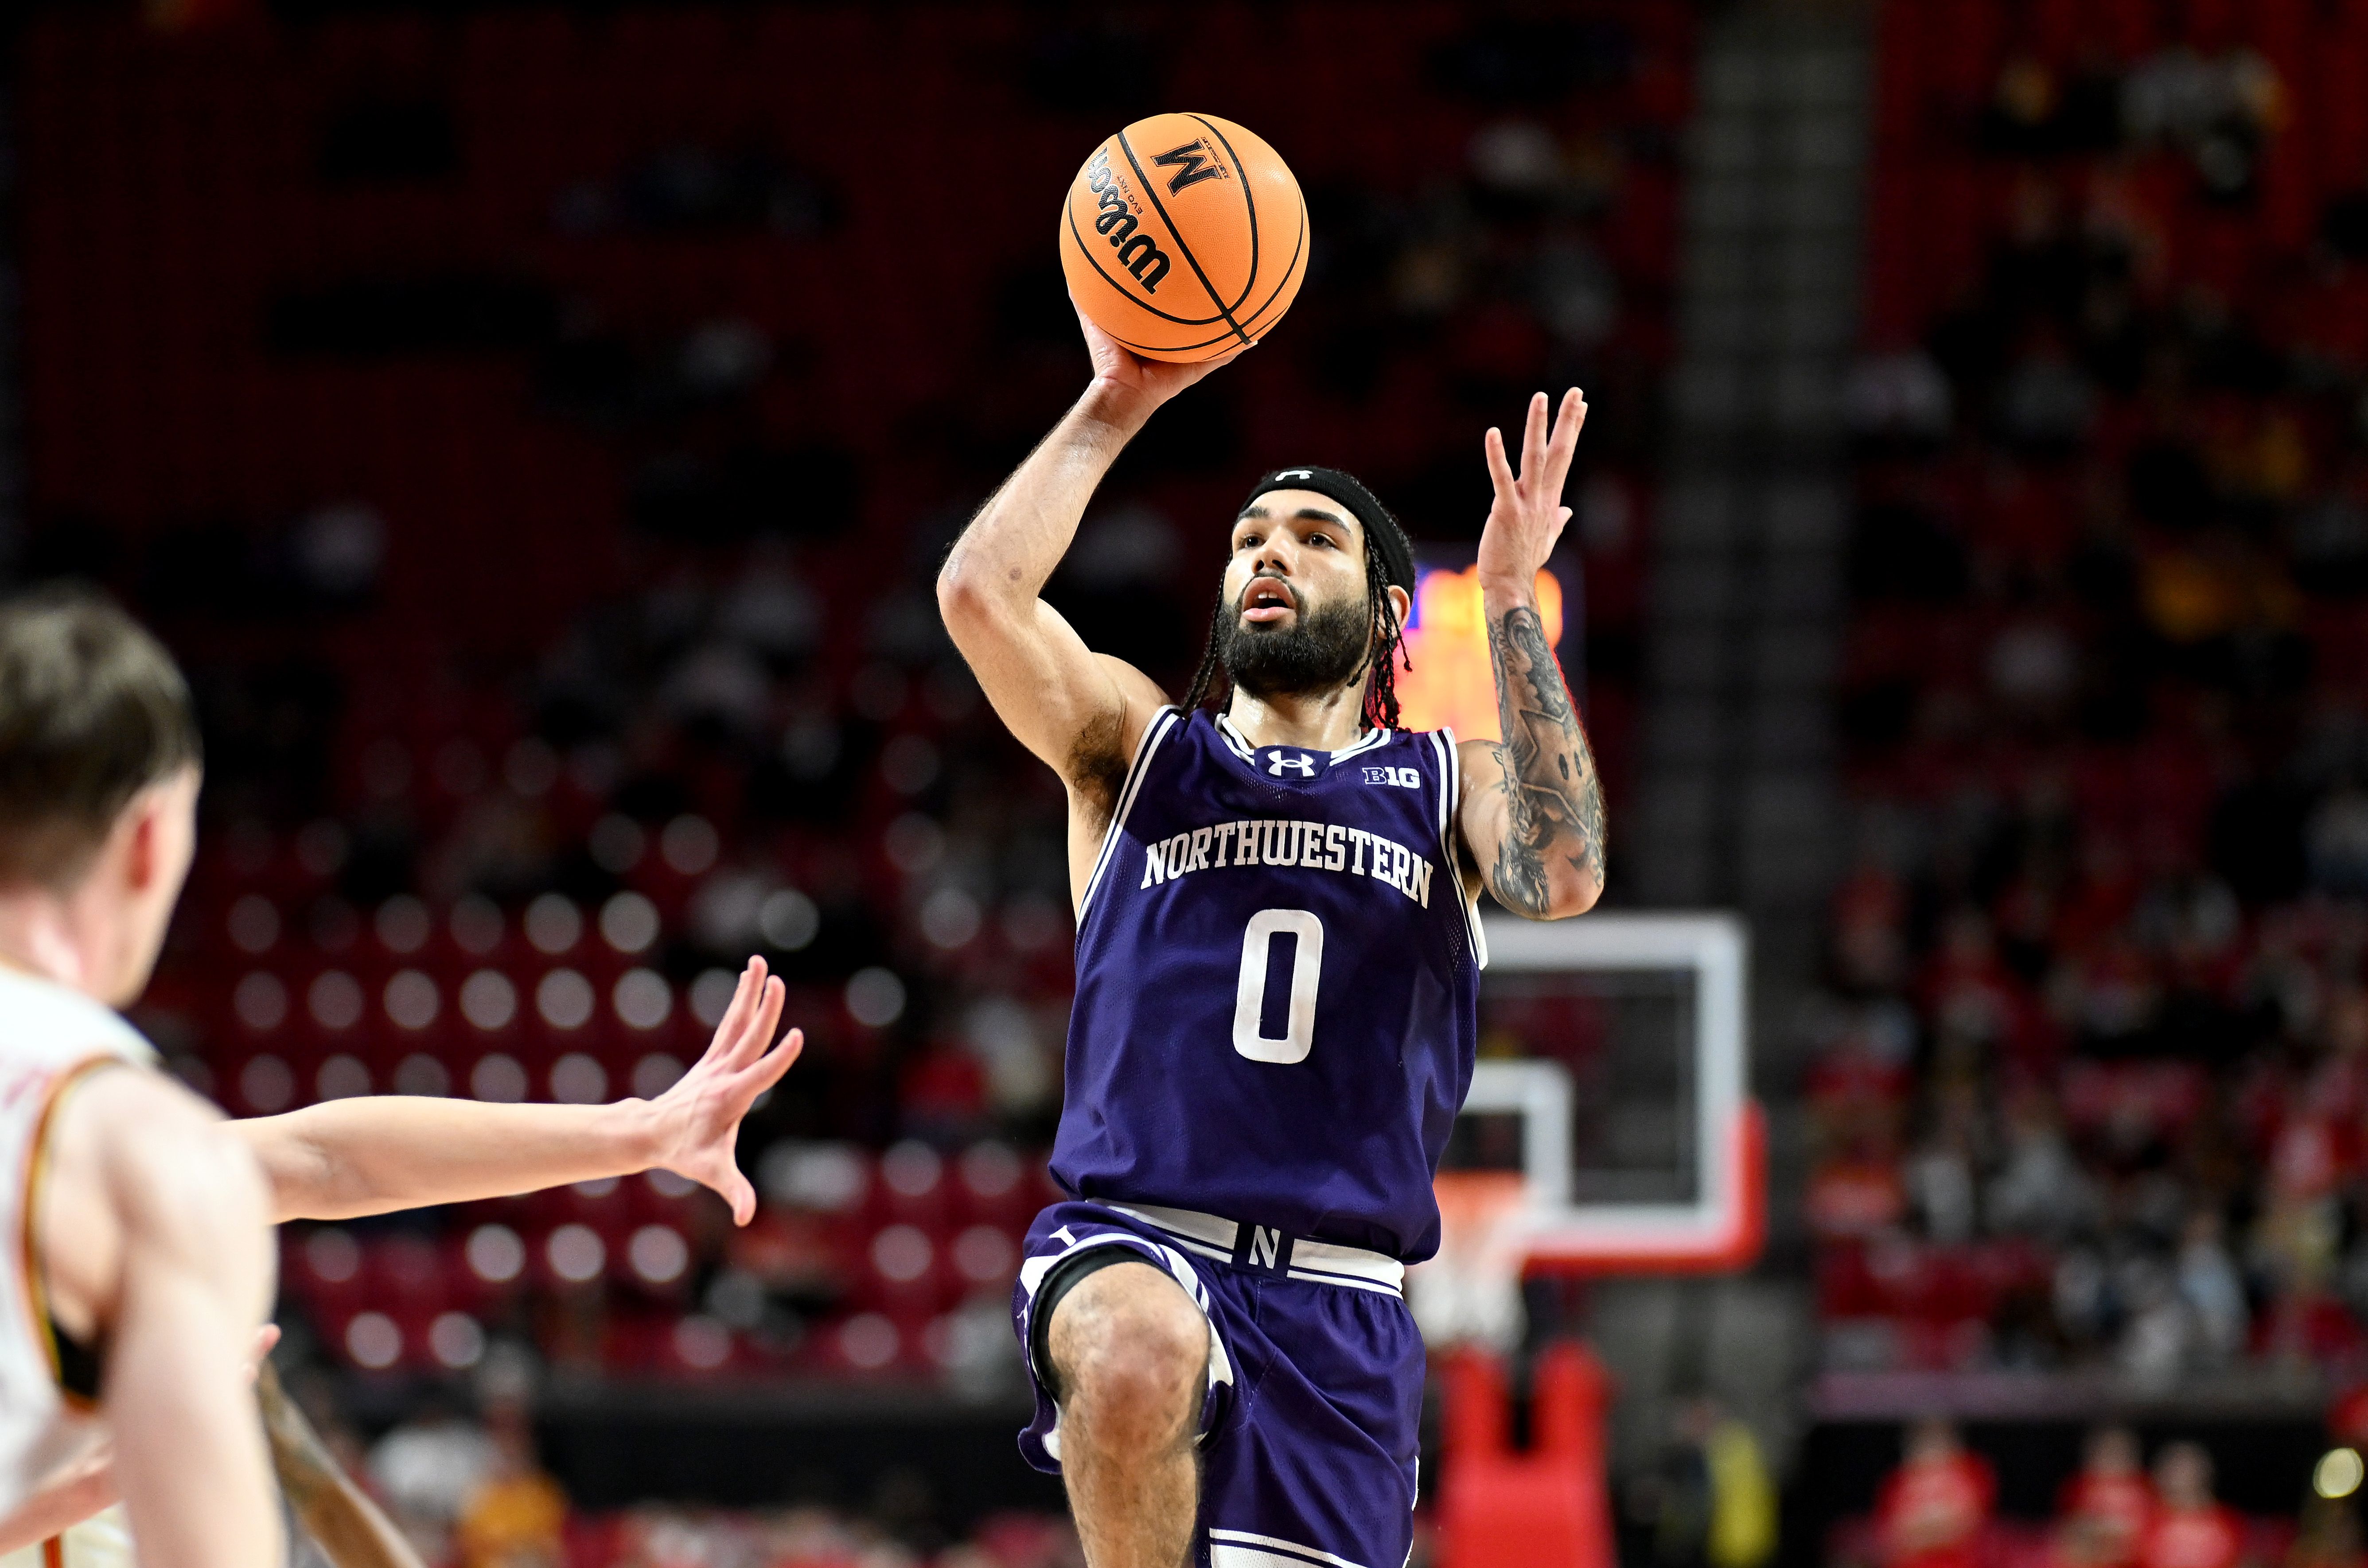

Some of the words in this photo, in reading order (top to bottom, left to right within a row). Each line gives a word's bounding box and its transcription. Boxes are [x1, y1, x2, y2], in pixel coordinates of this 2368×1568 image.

[1117, 175, 1130, 194] NXT
[1150, 138, 1223, 197] M
[1087, 145, 1171, 295] Wilson
[1128, 195, 1143, 215] EVO
[1141, 820, 1433, 909] NORTHWESTERN
[1232, 909, 1324, 1064] 0
[1248, 1225, 1281, 1269] N
